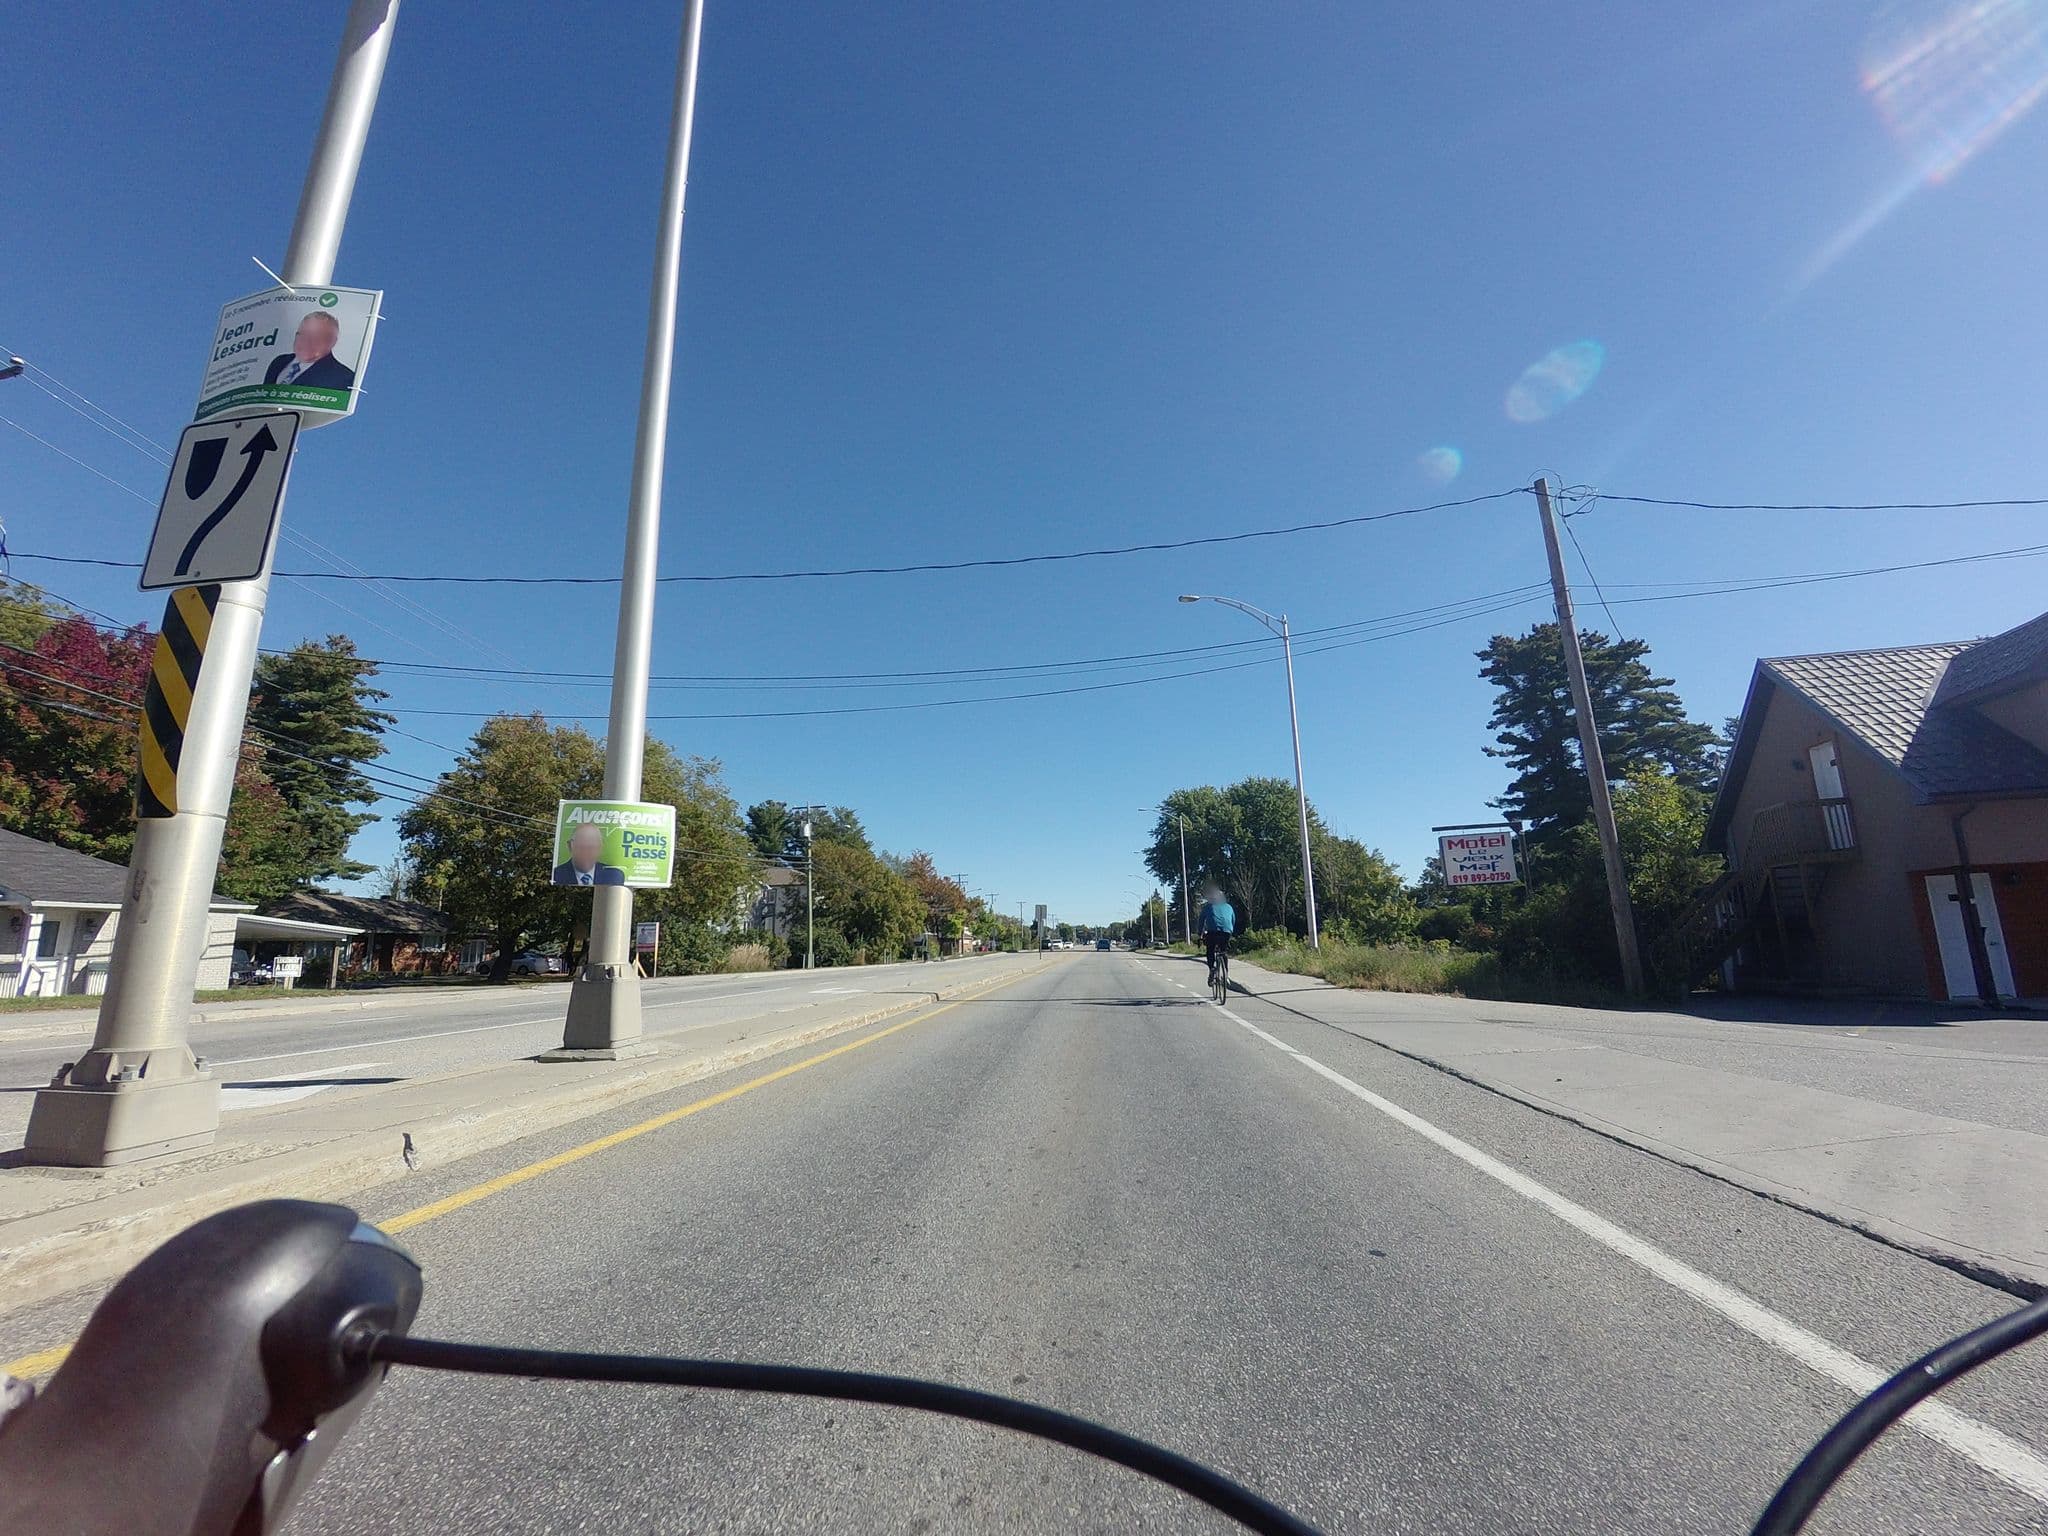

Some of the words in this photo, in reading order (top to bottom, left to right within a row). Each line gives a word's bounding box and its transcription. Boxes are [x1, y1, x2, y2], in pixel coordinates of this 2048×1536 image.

[218, 321, 254, 344] Jean
[212, 328, 279, 362] Lessard
[622, 831, 667, 846] Denis
[1447, 834, 1506, 850] Motel
[621, 844, 667, 860] Tassé
[1453, 874, 1468, 884] 819
